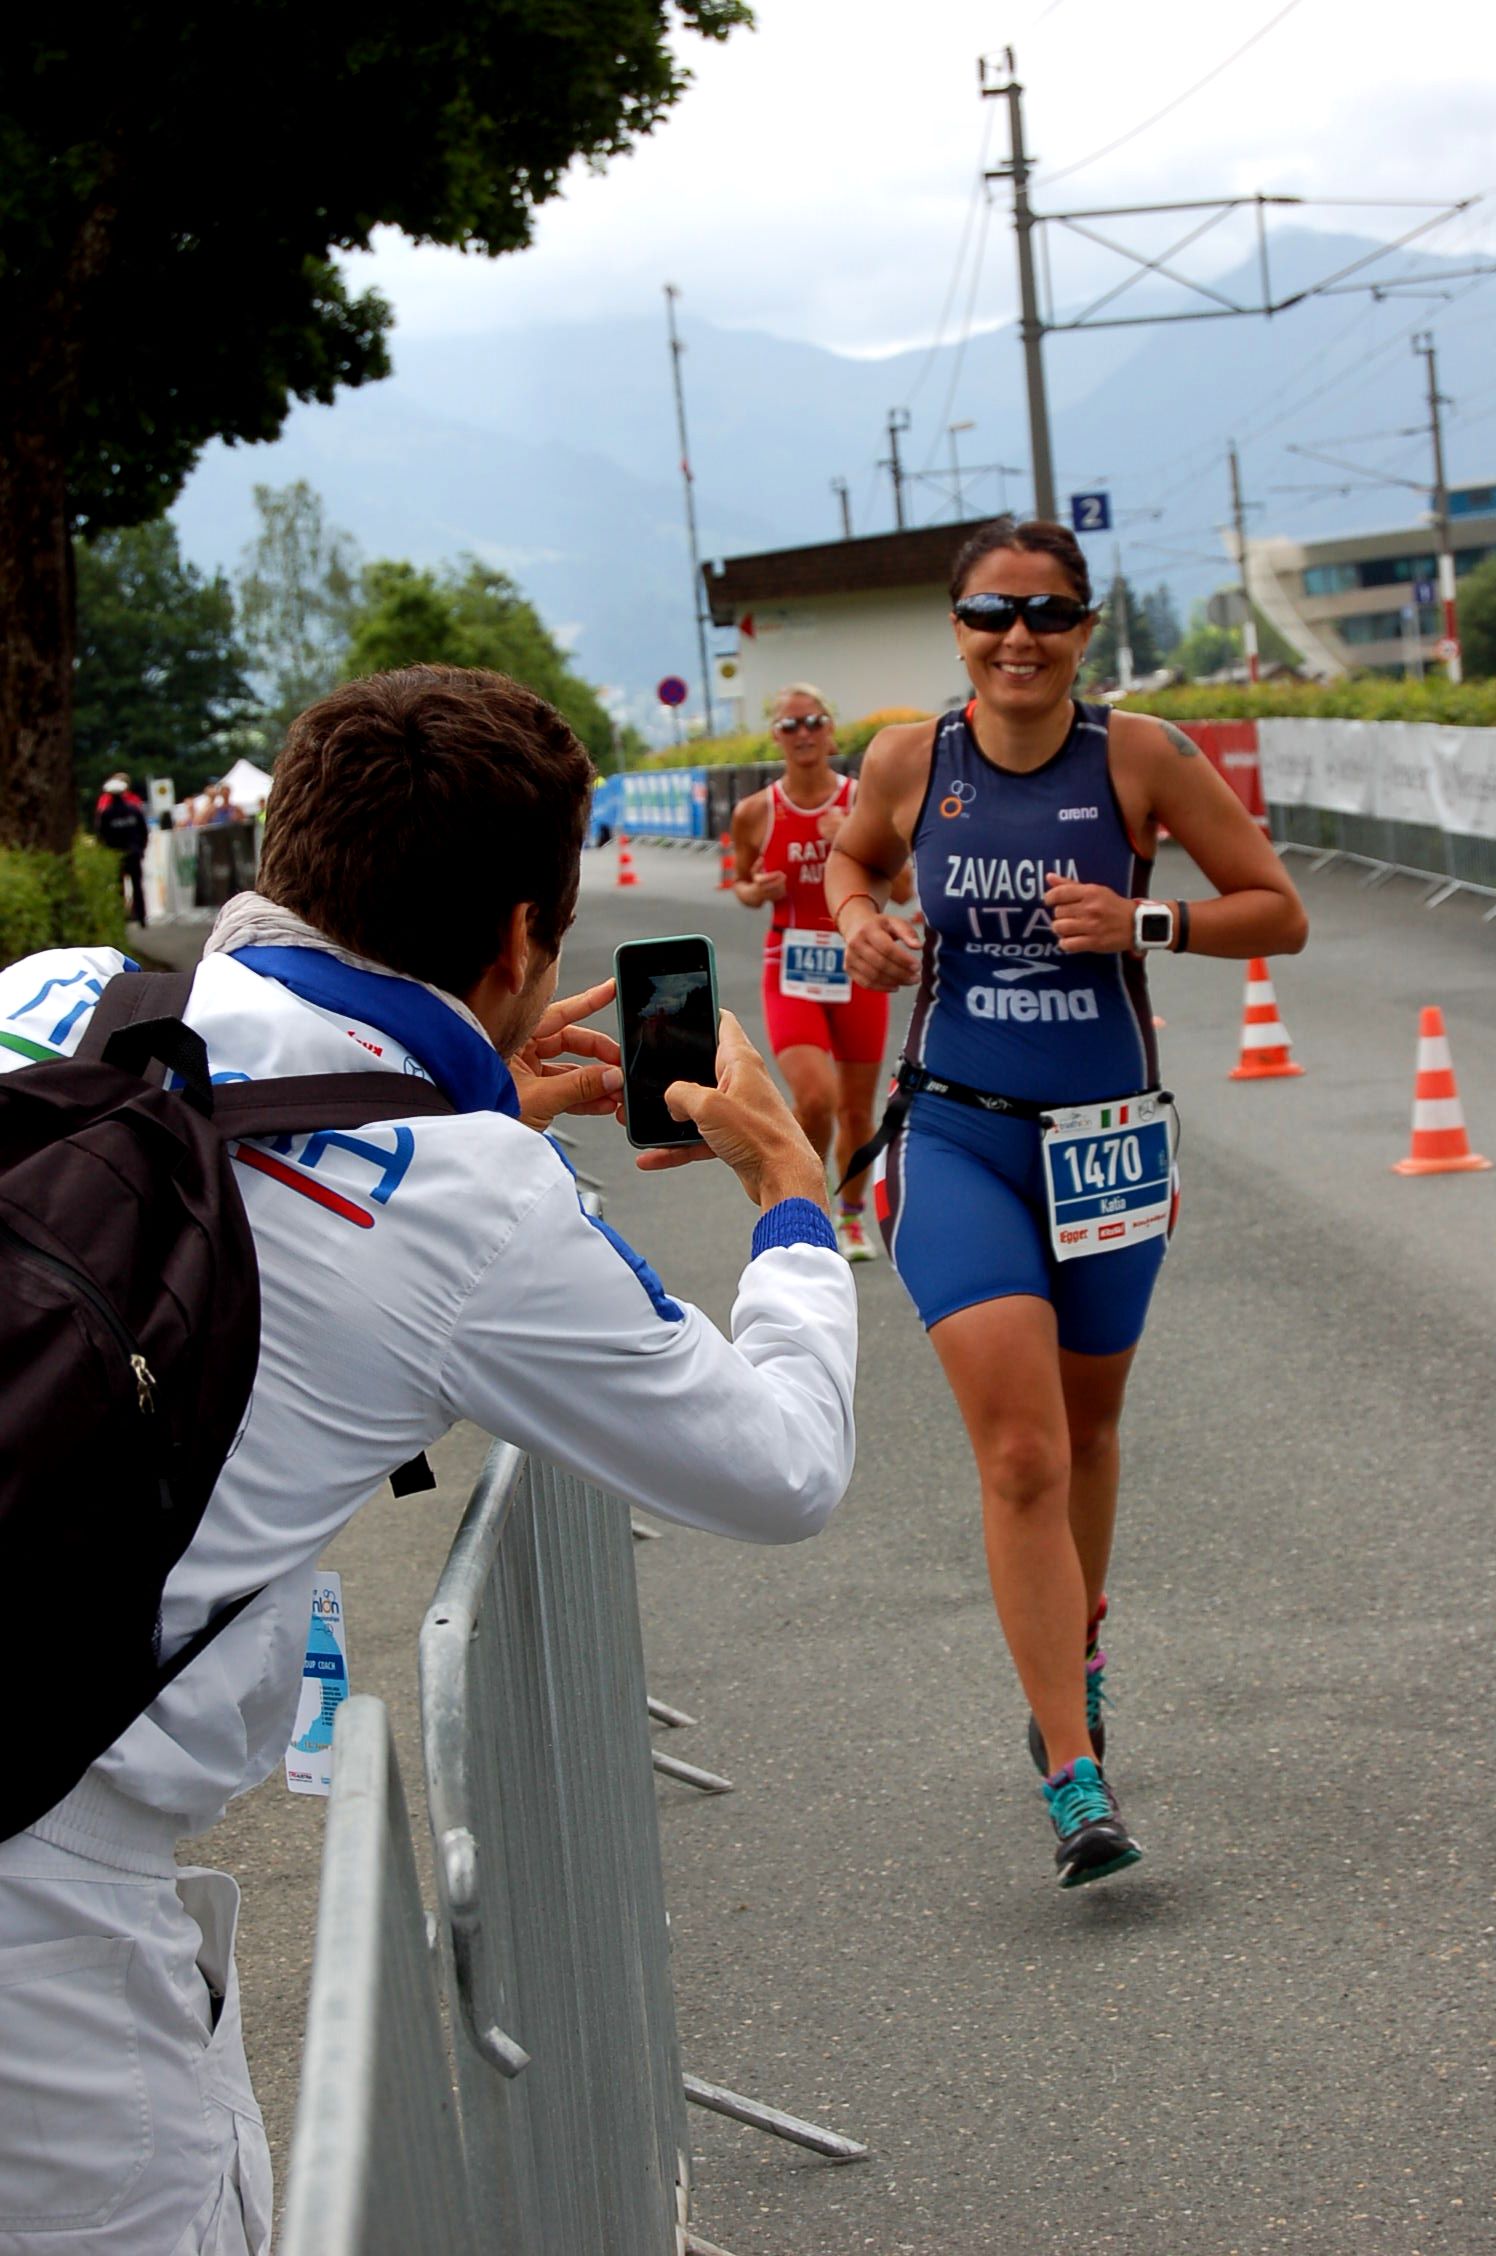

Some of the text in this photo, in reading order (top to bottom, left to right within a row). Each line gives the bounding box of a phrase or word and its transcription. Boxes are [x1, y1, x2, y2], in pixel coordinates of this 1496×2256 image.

[1080, 497, 1103, 528] 2
[1058, 806, 1098, 821] arena
[800, 863, 825, 883] AU
[968, 906, 1052, 938] ITA
[965, 942, 1070, 957] BROOK
[966, 985, 1100, 1022] arena
[1064, 1134, 1143, 1193] 1470
[1060, 1229, 1089, 1244] Egger
